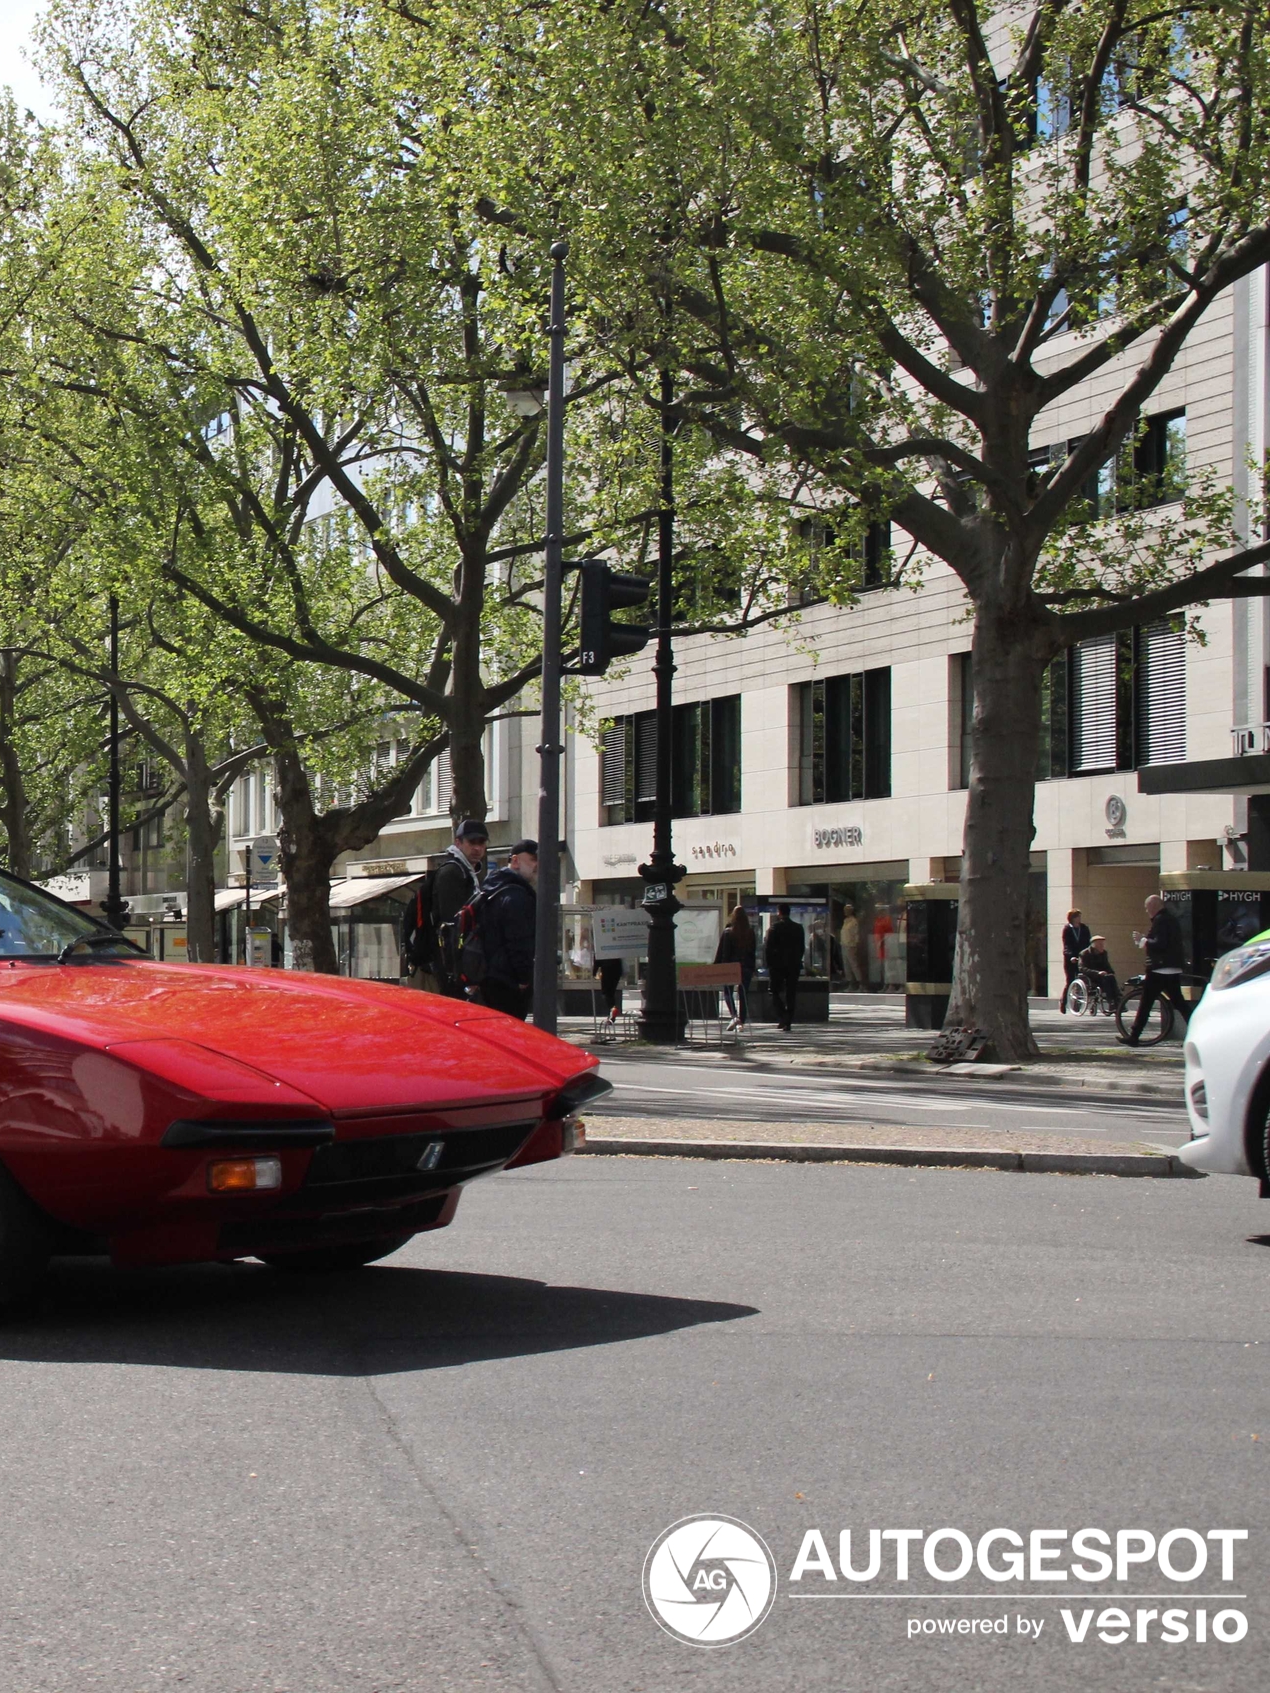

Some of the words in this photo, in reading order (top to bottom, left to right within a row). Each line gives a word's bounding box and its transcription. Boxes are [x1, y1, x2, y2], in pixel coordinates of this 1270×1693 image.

[582, 651, 595, 664] F3
[814, 826, 862, 846] BOGNER
[692, 841, 734, 856] sandro
[1170, 891, 1192, 901] HYGH
[1229, 891, 1261, 901] HYGH
